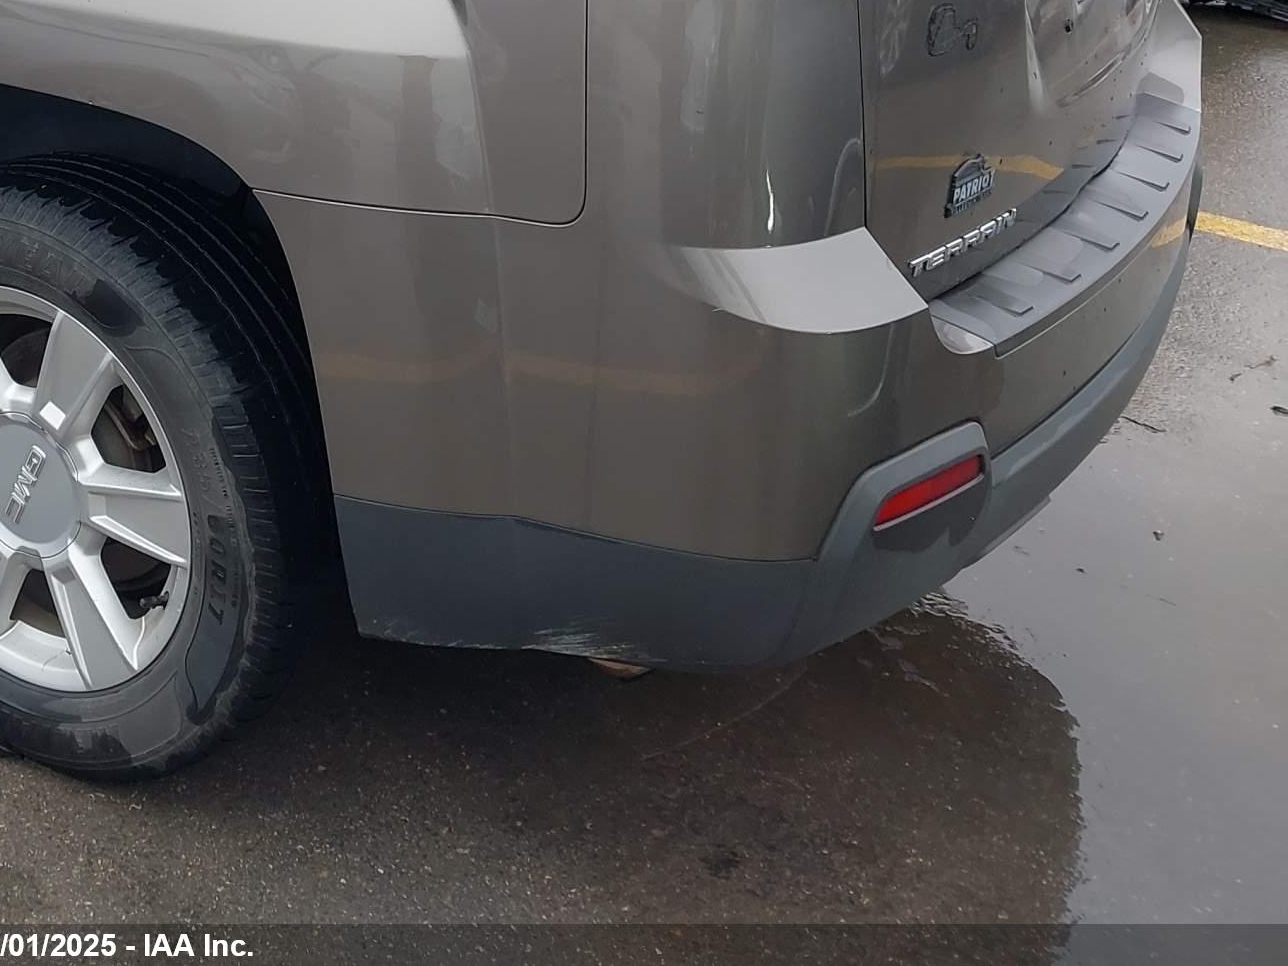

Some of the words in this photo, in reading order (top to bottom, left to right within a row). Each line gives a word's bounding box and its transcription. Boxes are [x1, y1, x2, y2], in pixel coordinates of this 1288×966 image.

[952, 169, 996, 206] PATRIOT
[909, 208, 1017, 277] TERRAIN
[5, 444, 47, 524] GMC
